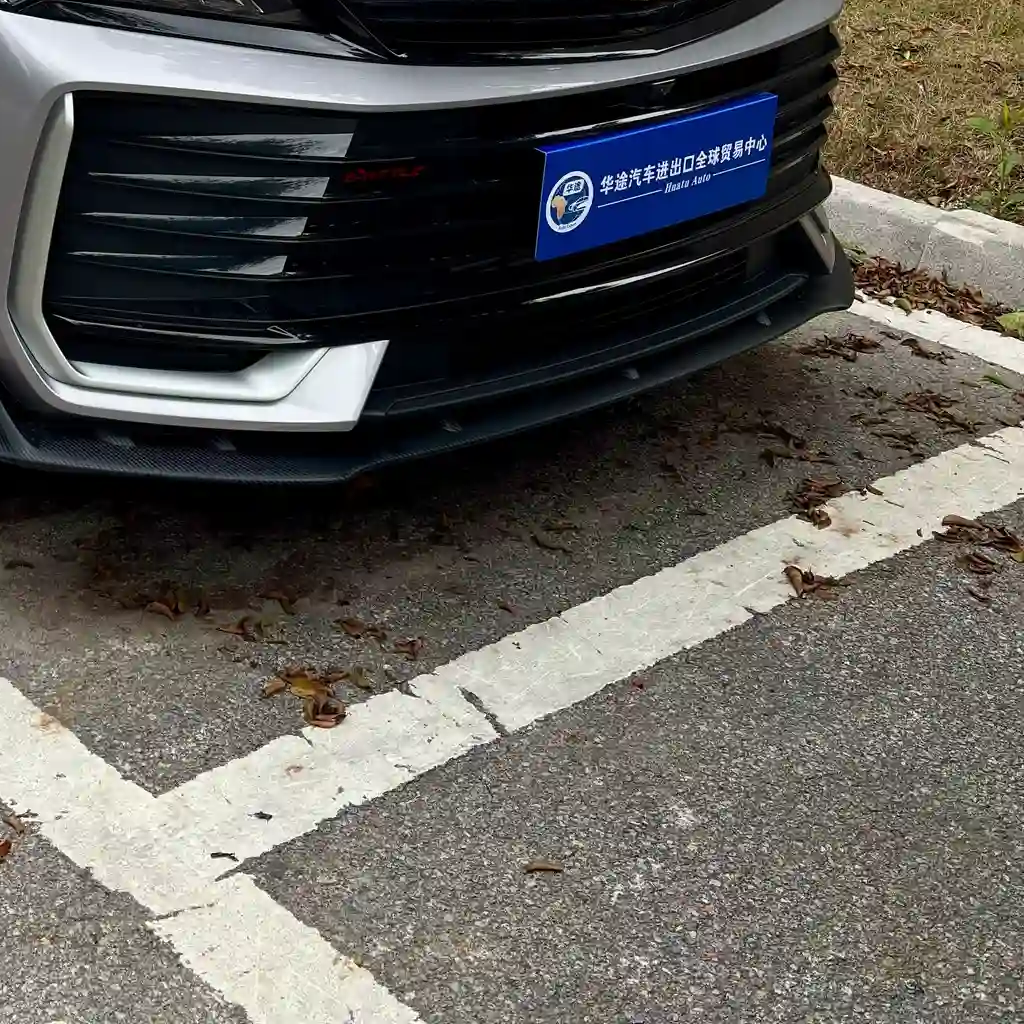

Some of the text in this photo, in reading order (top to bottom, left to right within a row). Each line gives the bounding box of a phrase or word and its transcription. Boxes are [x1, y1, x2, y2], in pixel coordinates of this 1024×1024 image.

[599, 133, 768, 196] 华途汽车进出口全球贸易中心
[691, 173, 712, 186] Auto
